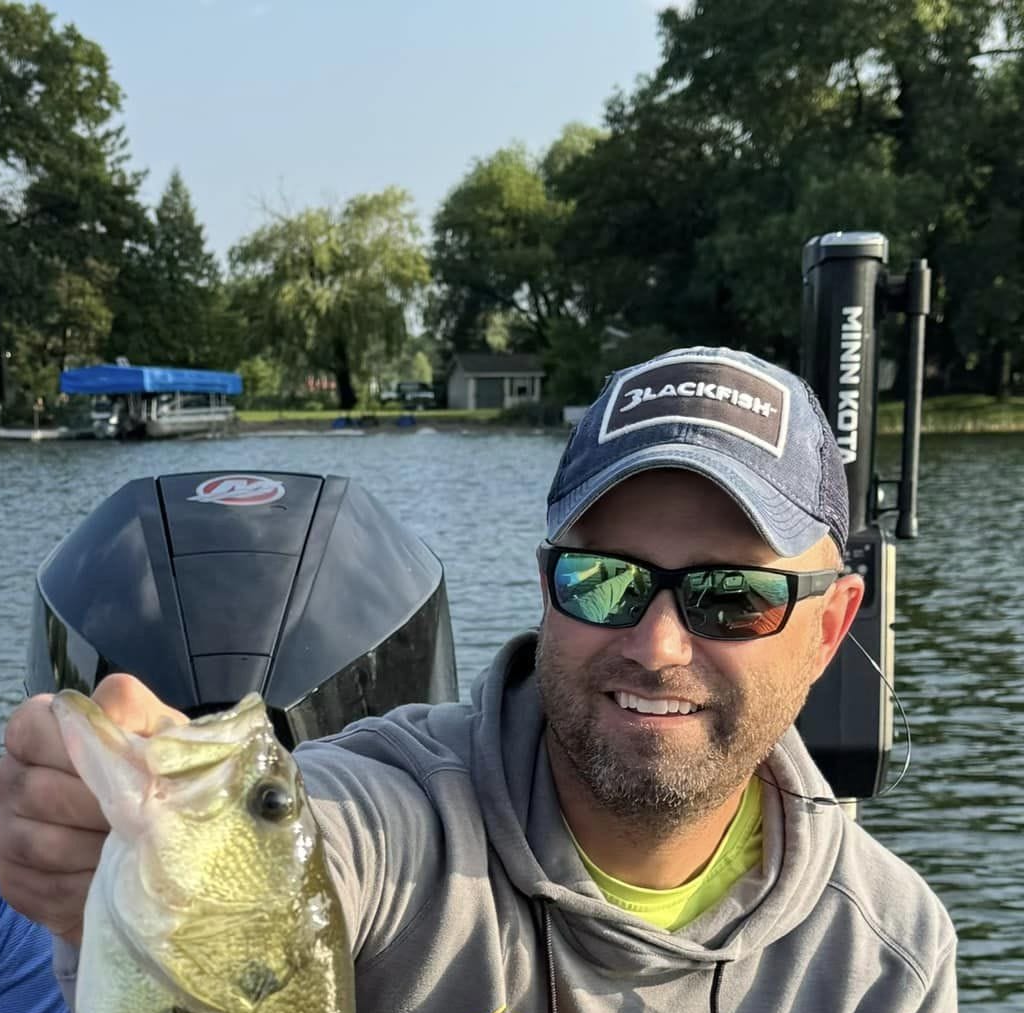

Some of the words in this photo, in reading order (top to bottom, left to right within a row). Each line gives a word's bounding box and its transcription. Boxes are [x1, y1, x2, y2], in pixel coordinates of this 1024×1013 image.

[839, 306, 864, 385] MINN
[620, 381, 773, 418] BLACKFISH
[836, 390, 861, 465] KOTA
